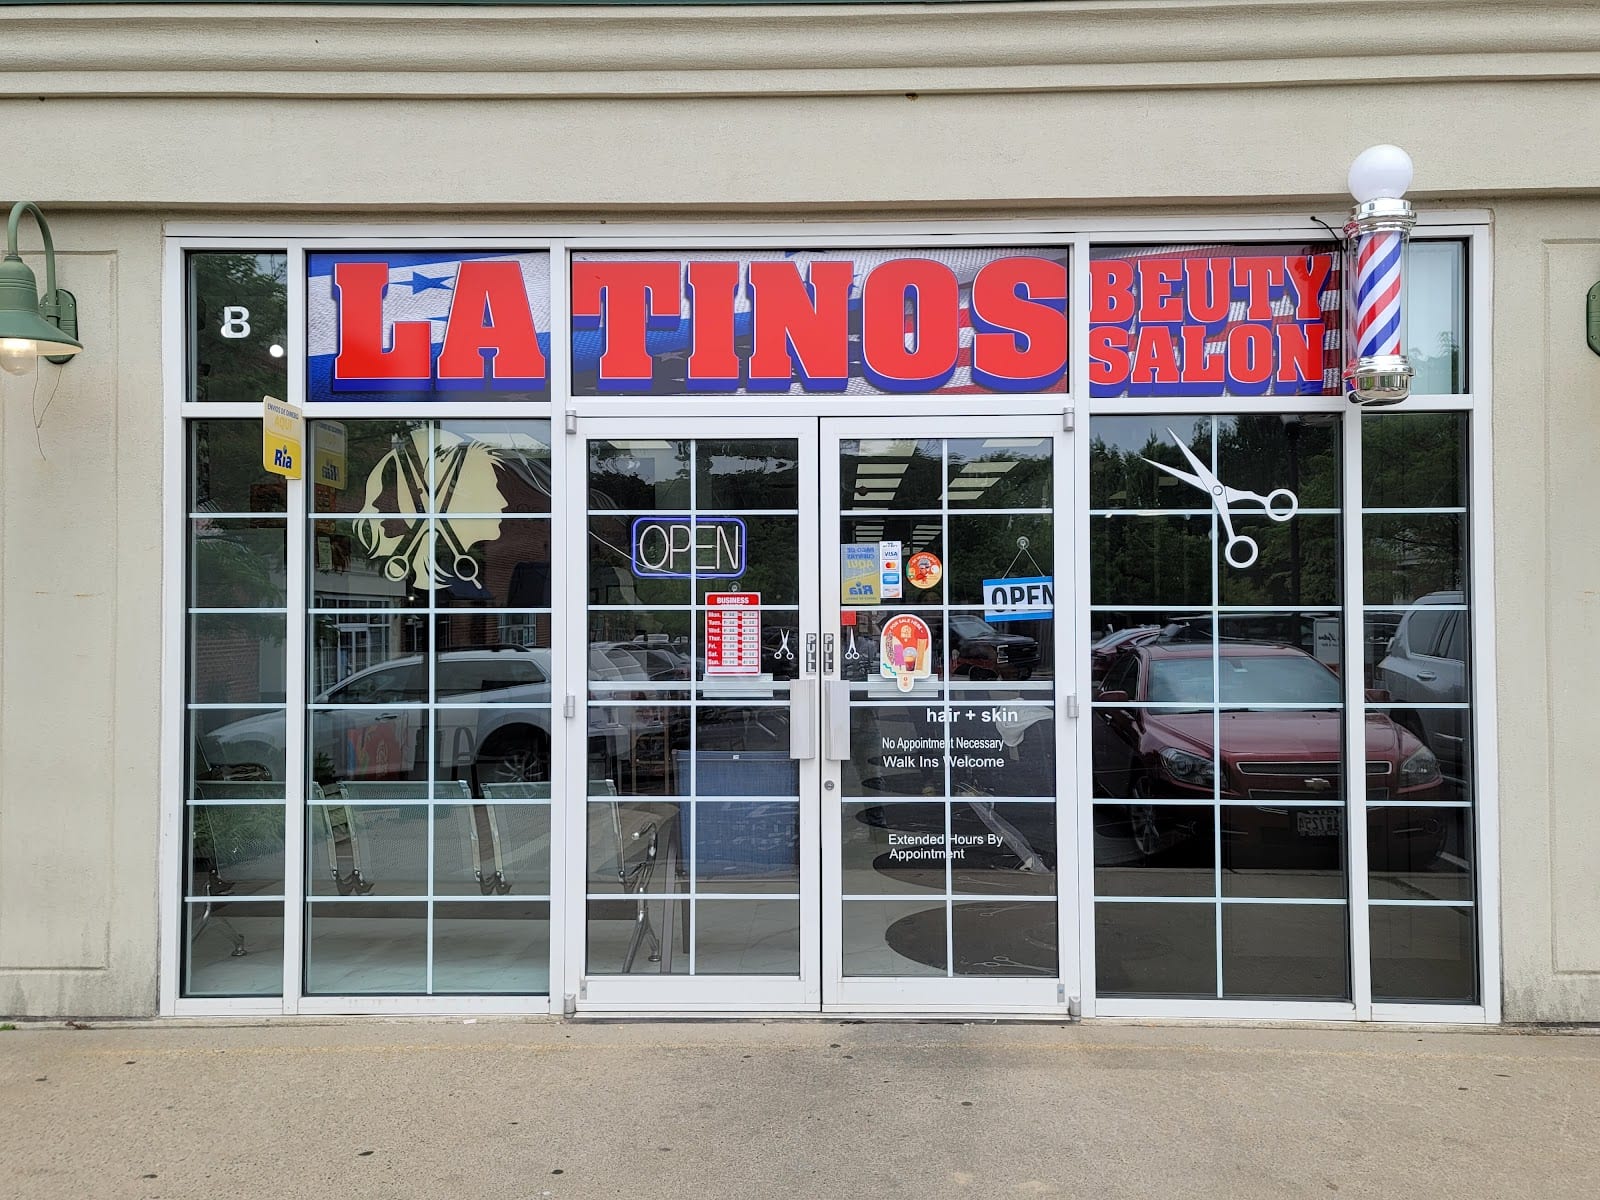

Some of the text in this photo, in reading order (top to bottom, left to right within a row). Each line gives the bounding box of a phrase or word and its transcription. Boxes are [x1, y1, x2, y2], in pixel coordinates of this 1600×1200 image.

[1089, 255, 1332, 323] BEUTY
[220, 305, 251, 339] B
[333, 256, 1067, 390] LATINOS
[1089, 324, 1325, 386] SALON
[274, 444, 292, 469] Ria
[640, 524, 739, 570] OPEN
[717, 596, 749, 604] BUSINESS
[807, 634, 816, 672] PULL
[824, 634, 833, 672] PULL
[926, 708, 960, 722] hair
[981, 707, 1018, 722] skin
[882, 737, 1004, 751] No Appointmet Necessary
[883, 755, 1005, 768] Walk Ins Welcome
[888, 833, 944, 845] Extended
[988, 833, 1003, 847] By
[889, 848, 965, 861] Appointment
